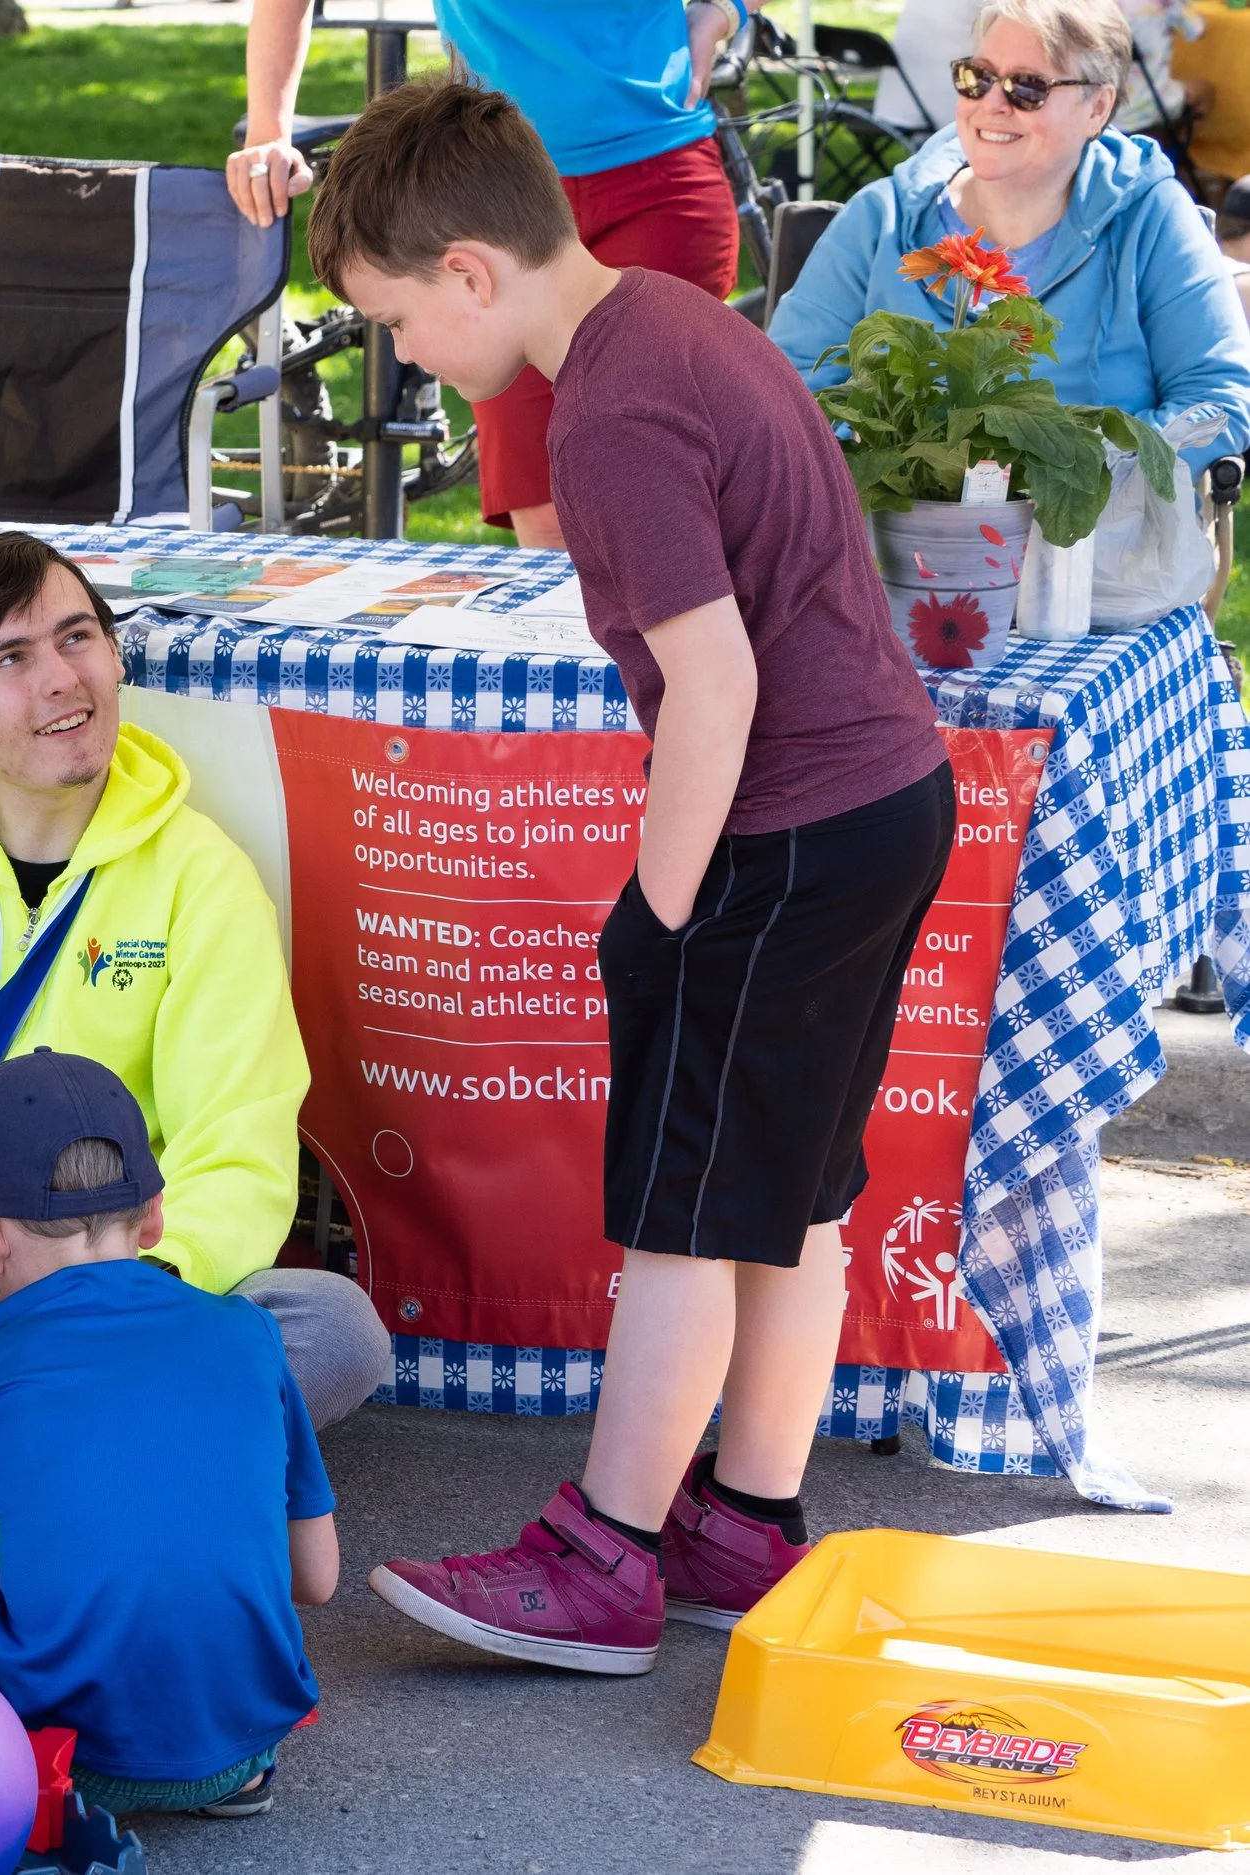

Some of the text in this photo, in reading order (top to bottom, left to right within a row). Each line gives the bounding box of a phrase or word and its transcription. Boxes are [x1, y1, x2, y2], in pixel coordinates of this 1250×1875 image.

[351, 768, 490, 812] Welcoming
[499, 781, 615, 807] athletes
[953, 780, 1009, 806] ties
[353, 804, 378, 829] of
[382, 809, 412, 835] all
[418, 820, 478, 845] ages
[486, 821, 516, 844] to
[520, 818, 575, 849] join
[583, 824, 632, 842] our
[953, 820, 1019, 848] port
[354, 844, 536, 879] opportunities.
[116, 939, 140, 949] Special
[356, 908, 973, 952] WANTED: Coaches our
[113, 960, 166, 969] Kamloops 2023
[115, 950, 165, 959] Winter Games
[358, 943, 418, 974] team
[426, 957, 471, 982] and
[480, 957, 554, 982] make
[561, 963, 577, 981] a
[358, 982, 464, 1015] seasonal
[470, 991, 577, 1017] athletic
[895, 1003, 986, 1027] events.
[519, 1590, 547, 1613] DC
[903, 1718, 1088, 1769] BEYBLADE
[914, 1750, 1058, 1775] LEGENDS
[972, 1786, 1067, 1809] BEYSTADIUM
